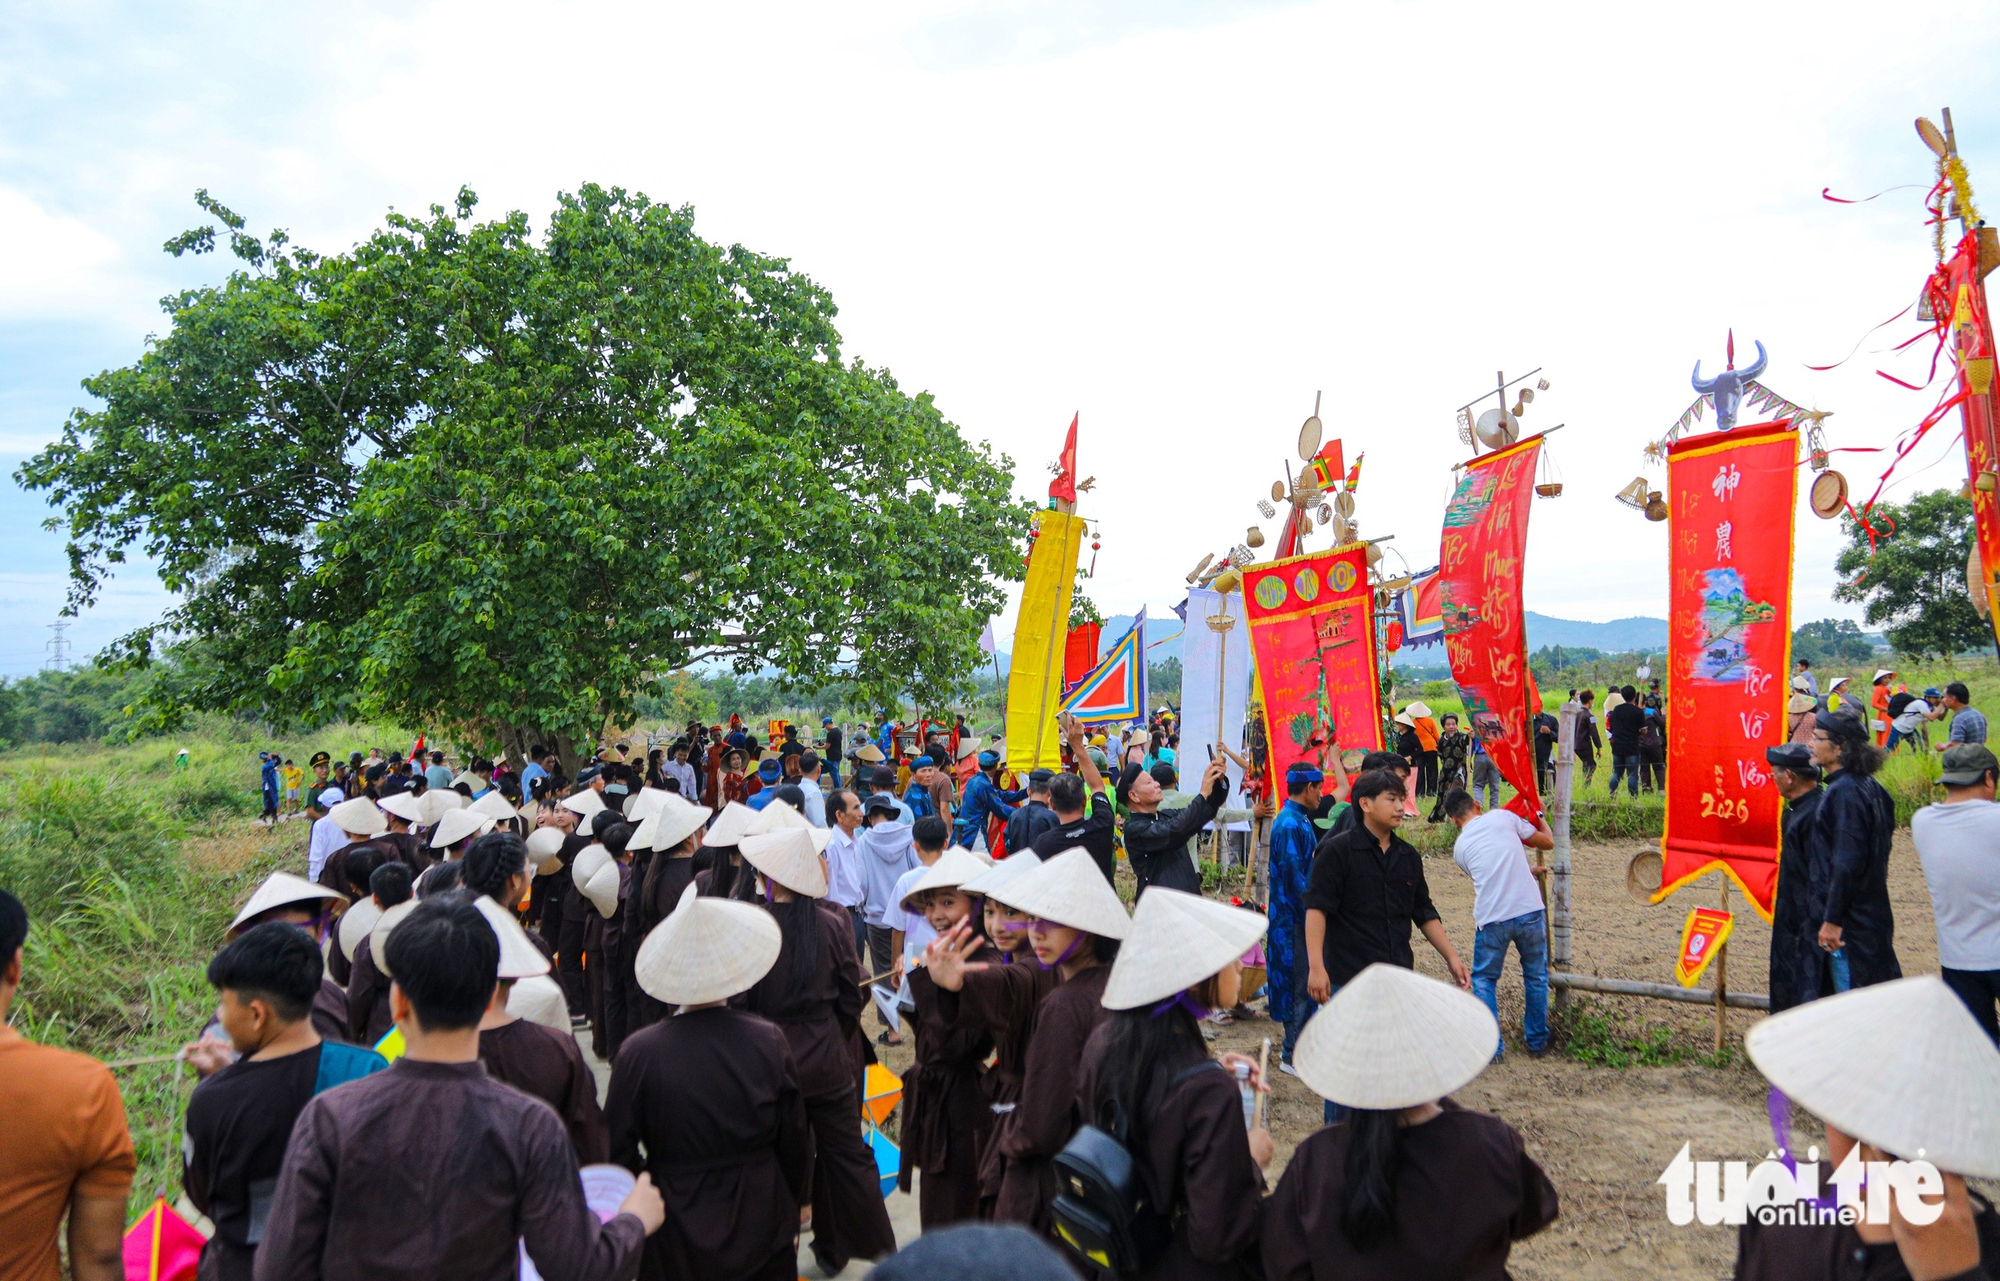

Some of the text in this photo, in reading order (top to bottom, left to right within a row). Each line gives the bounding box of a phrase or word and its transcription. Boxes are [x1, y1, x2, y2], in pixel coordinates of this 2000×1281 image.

[1737, 664, 1773, 790] Tộc Võ Văn
[1701, 791, 1750, 827] 2026
